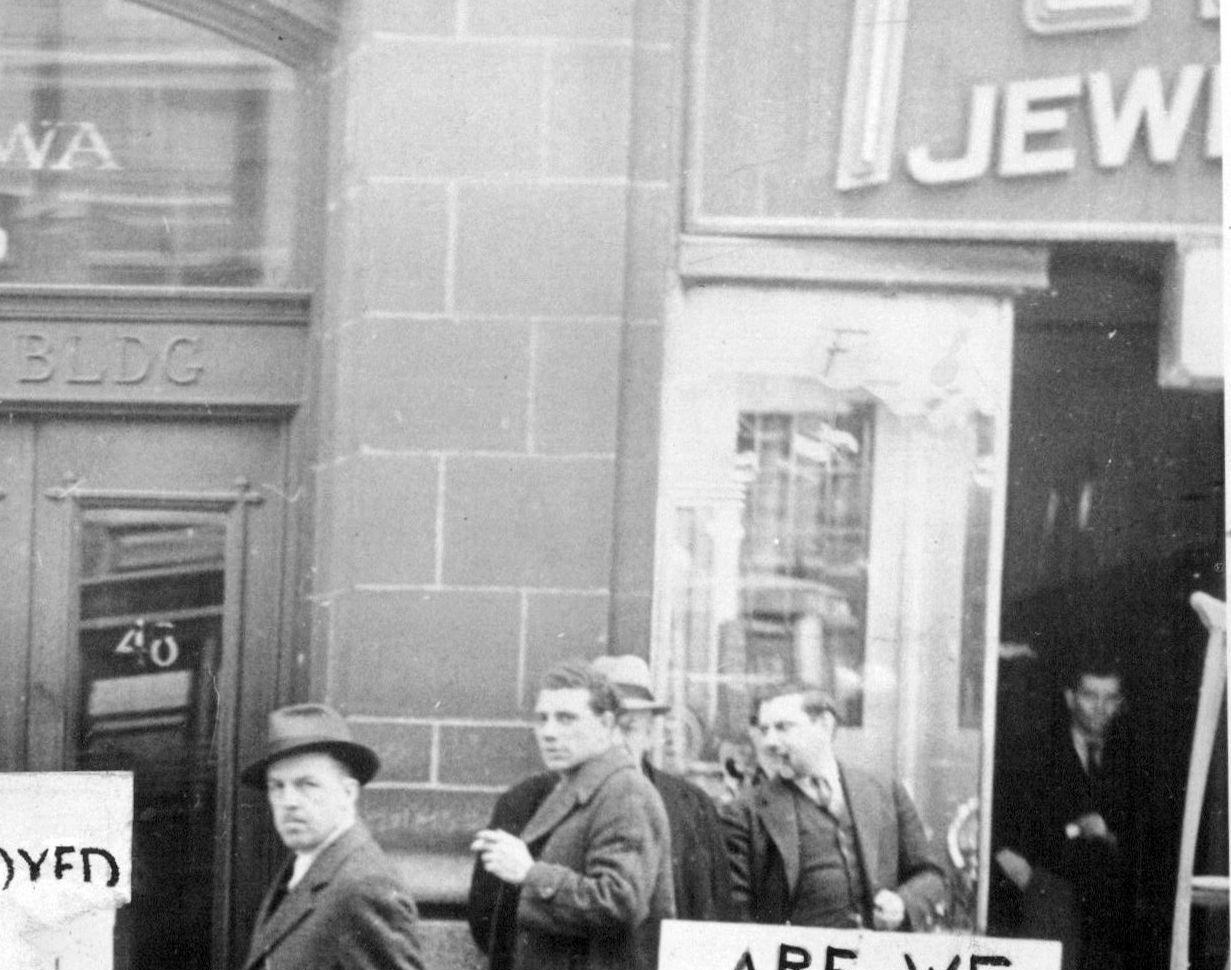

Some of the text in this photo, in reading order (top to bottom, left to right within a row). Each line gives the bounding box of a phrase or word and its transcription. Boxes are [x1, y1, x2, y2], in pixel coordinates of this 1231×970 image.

[905, 63, 1222, 185] JEW
[17, 333, 205, 386] BLDG
[115, 618, 179, 667] 40
